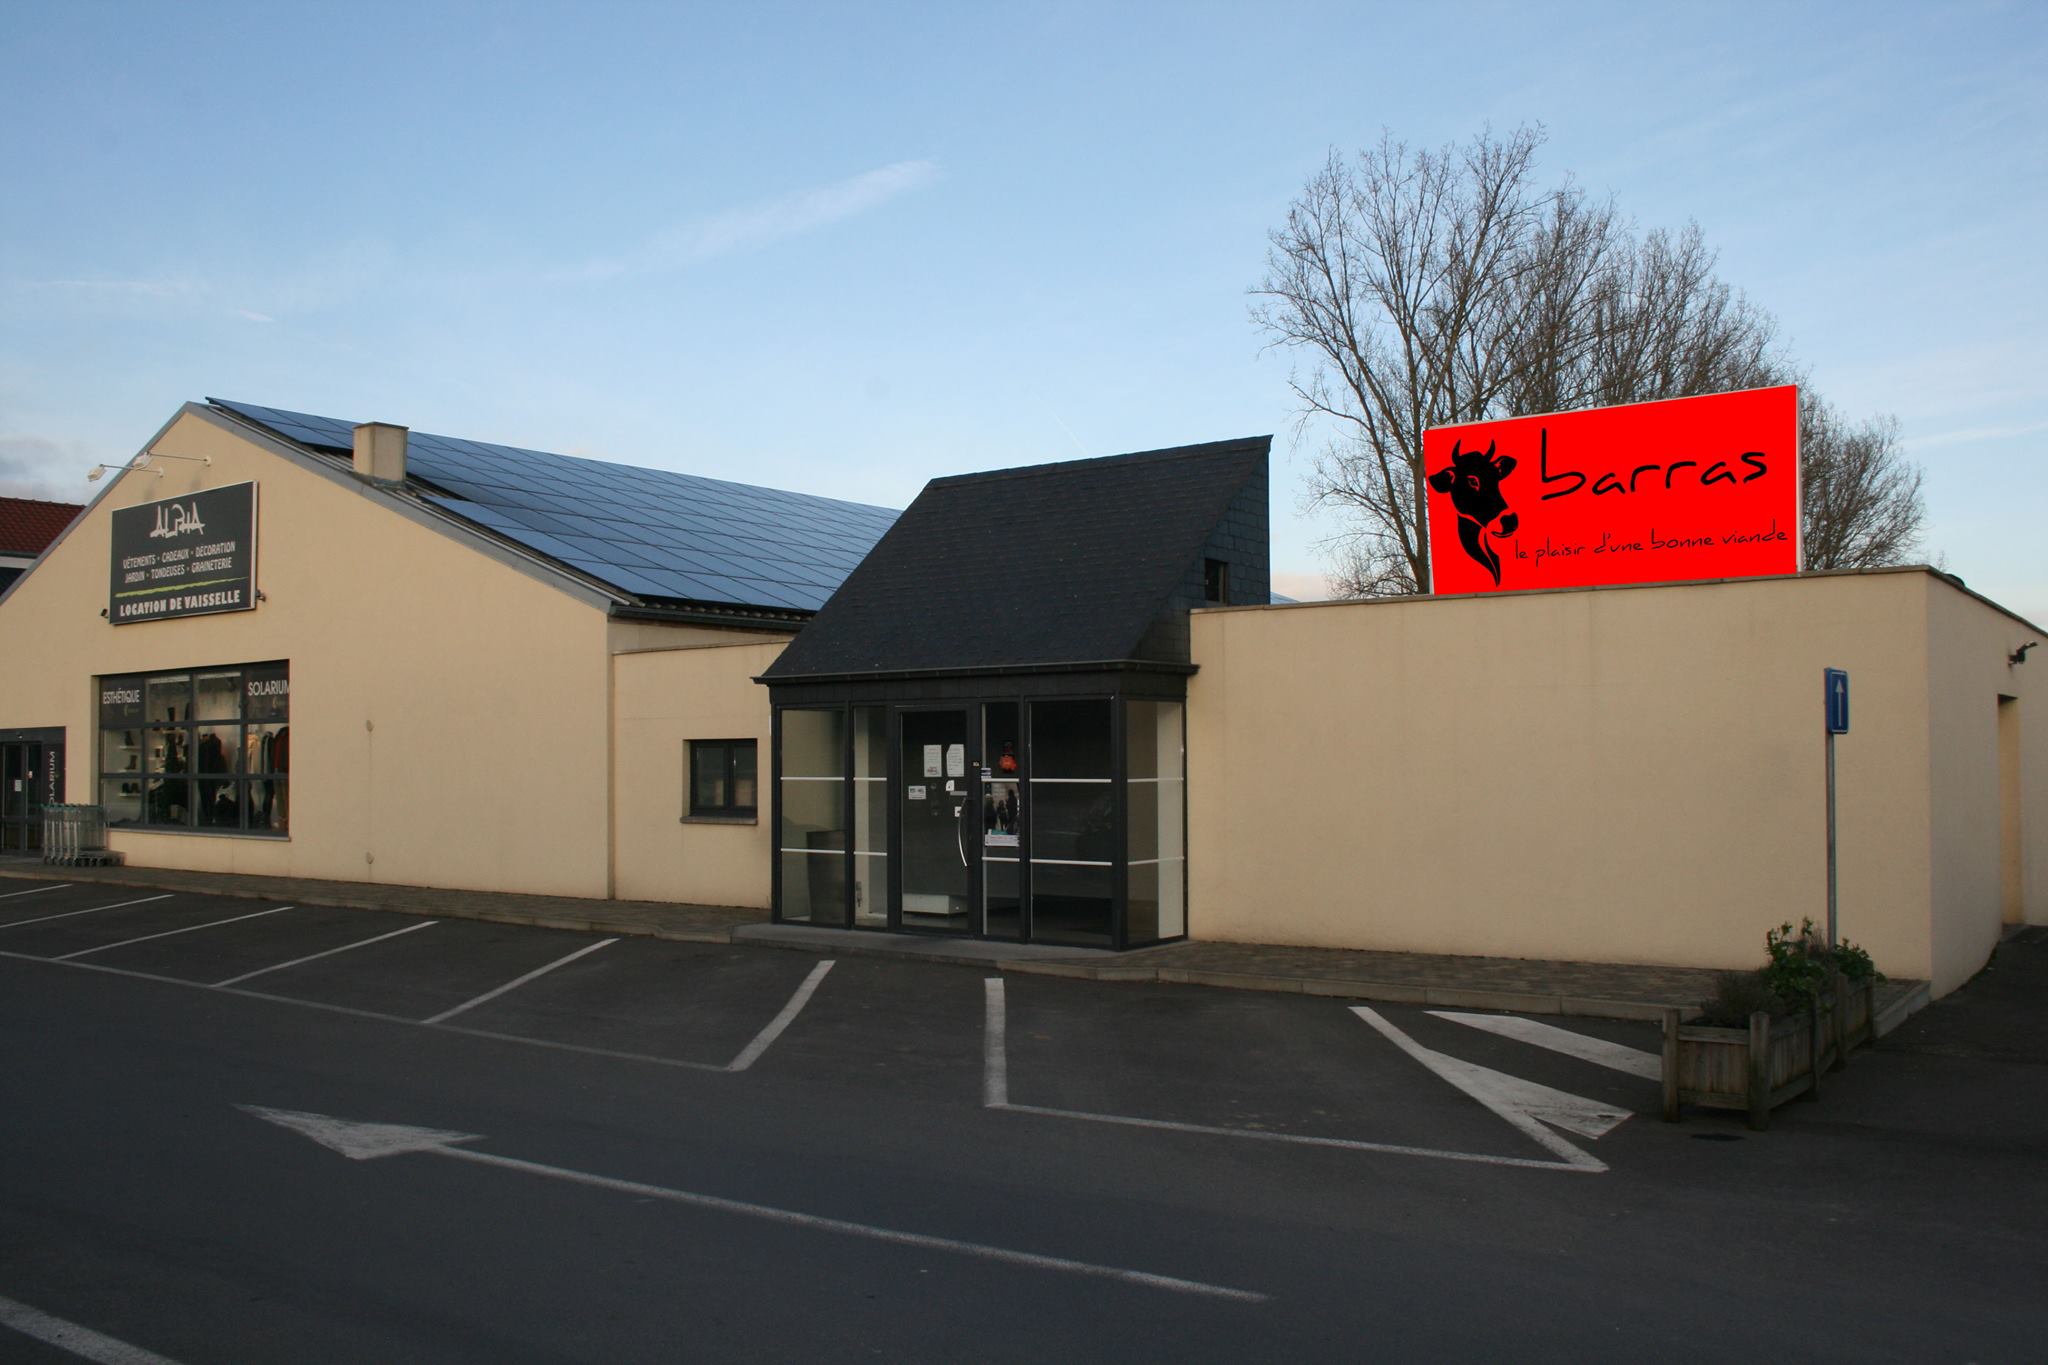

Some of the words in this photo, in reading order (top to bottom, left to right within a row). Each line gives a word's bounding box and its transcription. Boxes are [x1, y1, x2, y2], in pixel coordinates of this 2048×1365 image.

[1541, 427, 1767, 501] barras
[1515, 538, 1529, 559] le
[1535, 536, 1586, 568] plaisir
[1593, 531, 1644, 554] d'une
[1651, 527, 1715, 550] bonne
[1721, 518, 1788, 545] viande
[152, 564, 185, 578] TONDEUSES
[191, 557, 232, 573] GRAINETERIE
[162, 549, 189, 563] CADEAUX
[120, 599, 166, 616] LOCATION
[169, 597, 182, 610] DE
[185, 590, 240, 608] VAISSELLE
[103, 687, 140, 705] ESTHÉTIQUE
